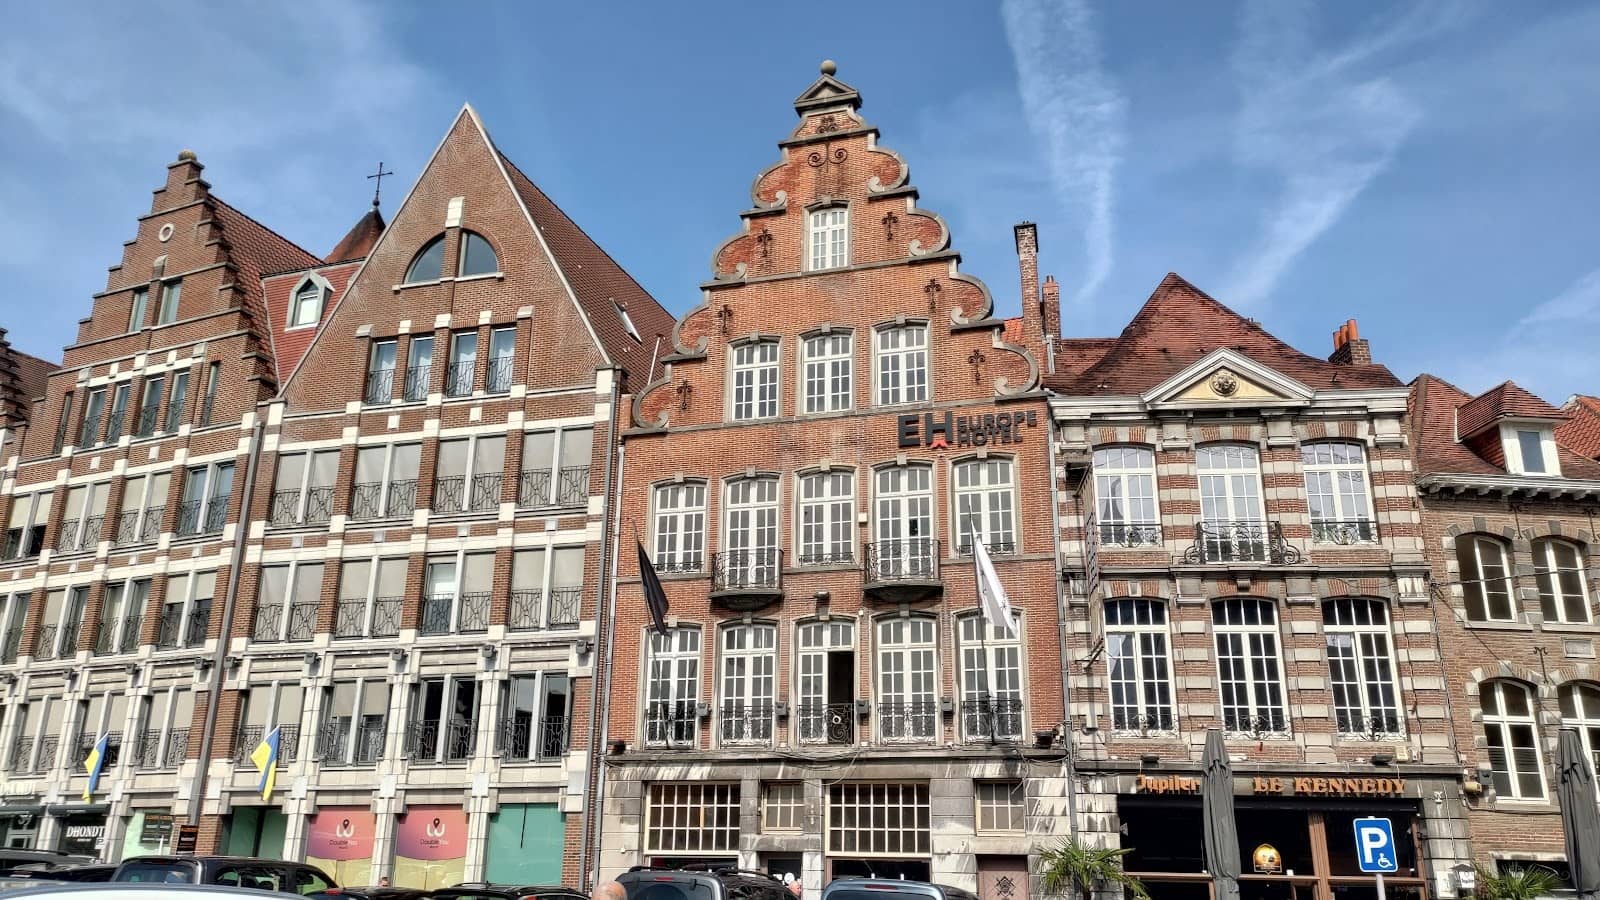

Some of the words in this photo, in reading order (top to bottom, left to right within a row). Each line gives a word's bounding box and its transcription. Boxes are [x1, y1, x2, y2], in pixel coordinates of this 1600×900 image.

[898, 411, 953, 448] EH
[957, 410, 1037, 433] EUROPE
[957, 426, 1023, 447] HOTEL
[1136, 774, 1200, 794] Jupiler
[1253, 776, 1285, 793] LE
[1294, 777, 1407, 794] KENNEDY
[66, 826, 105, 838] DHONDT
[1360, 827, 1388, 864] P
